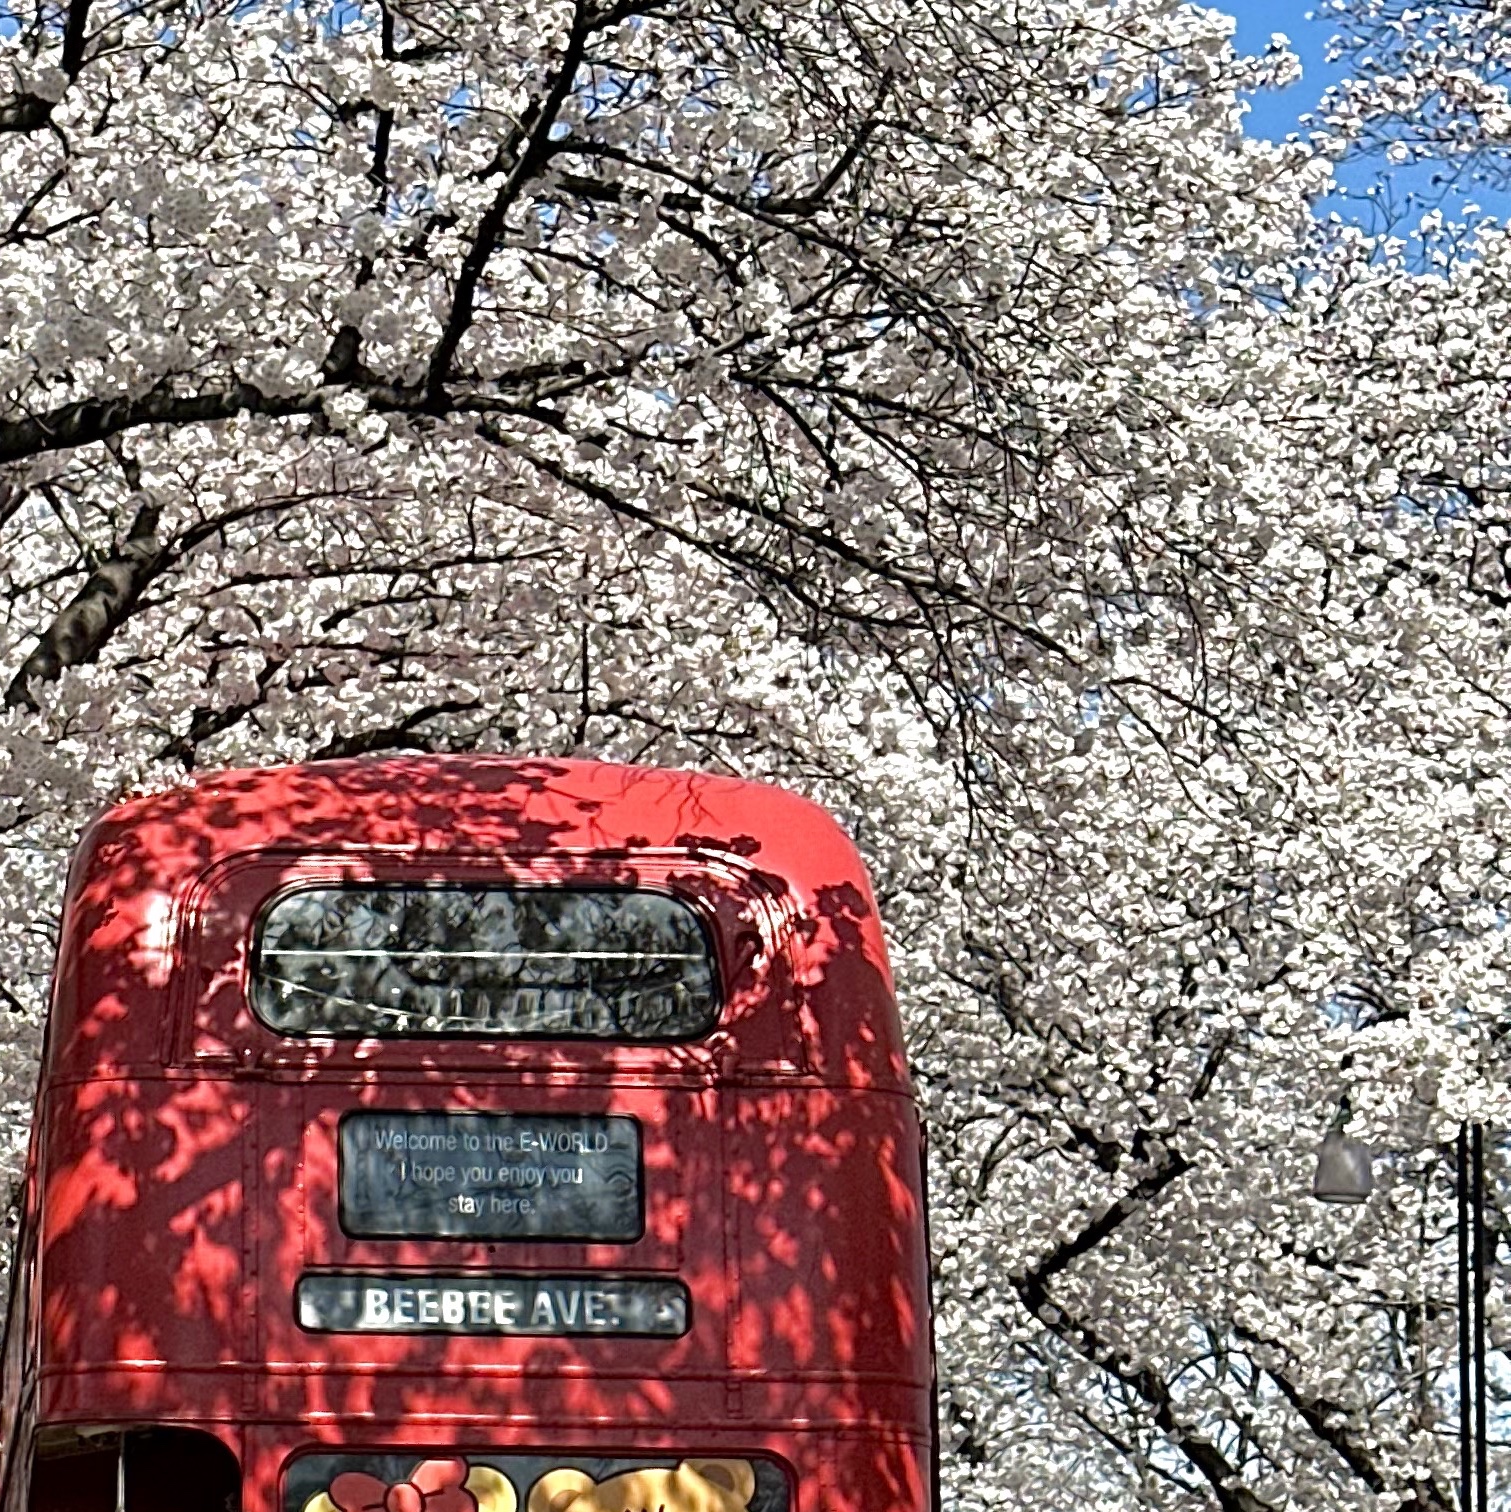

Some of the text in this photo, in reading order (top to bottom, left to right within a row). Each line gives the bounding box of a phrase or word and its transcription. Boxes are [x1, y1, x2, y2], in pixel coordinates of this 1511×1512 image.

[375, 1129, 609, 1153] Welcome to the E-WORLD
[412, 1160, 456, 1184] hope
[461, 1167, 493, 1185] you
[498, 1165, 546, 1187] enjoy
[550, 1167, 583, 1187] you
[448, 1194, 536, 1217] stay here.
[364, 1287, 620, 1326] BEEBEE AVE.
